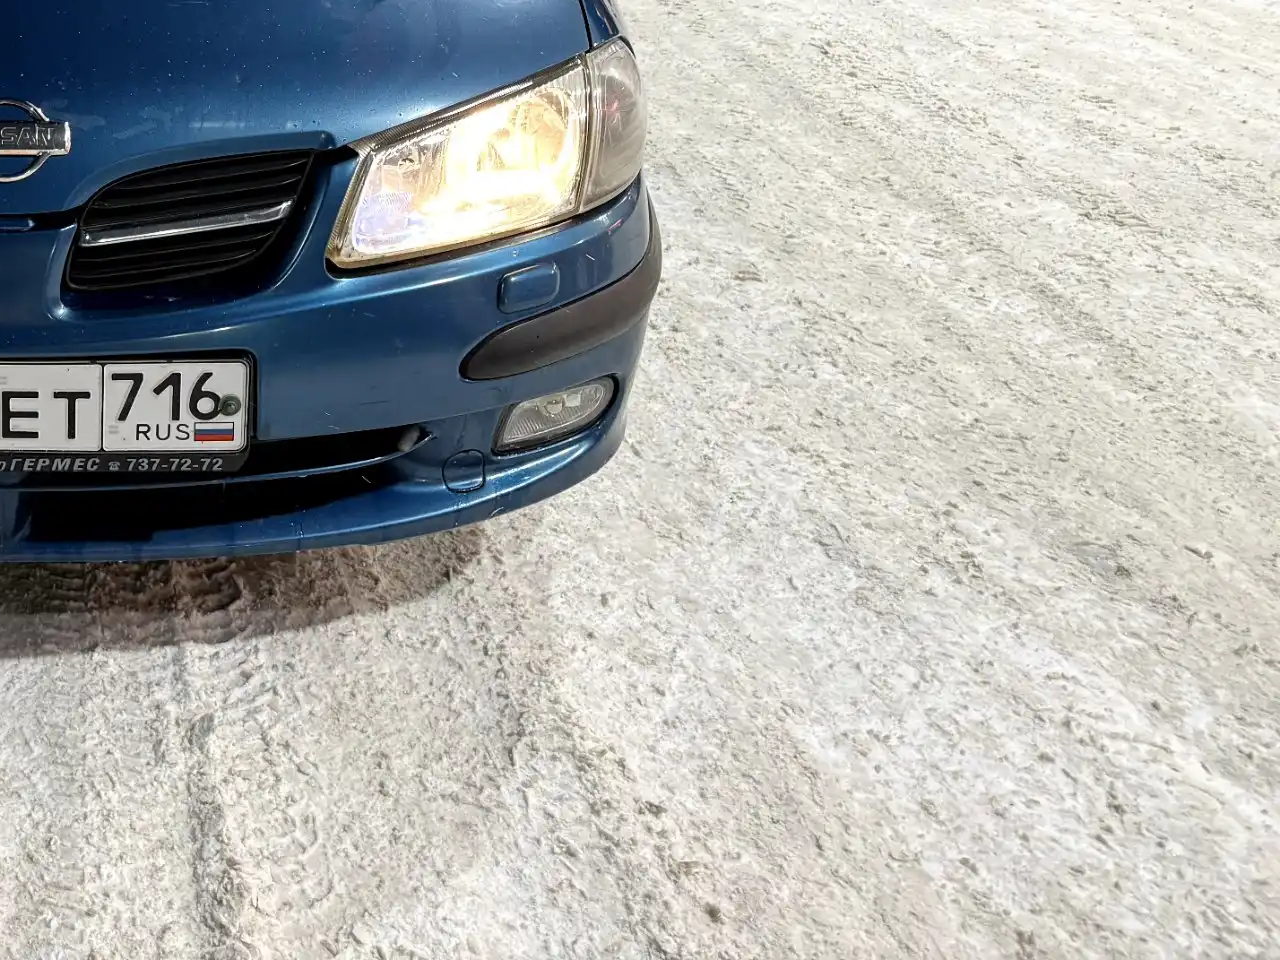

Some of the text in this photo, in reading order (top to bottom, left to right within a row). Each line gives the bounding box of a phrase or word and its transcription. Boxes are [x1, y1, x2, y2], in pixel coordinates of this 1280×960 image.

[111, 372, 222, 422] 716
[135, 423, 190, 441] RUS
[126, 458, 224, 471] 737-72-72
